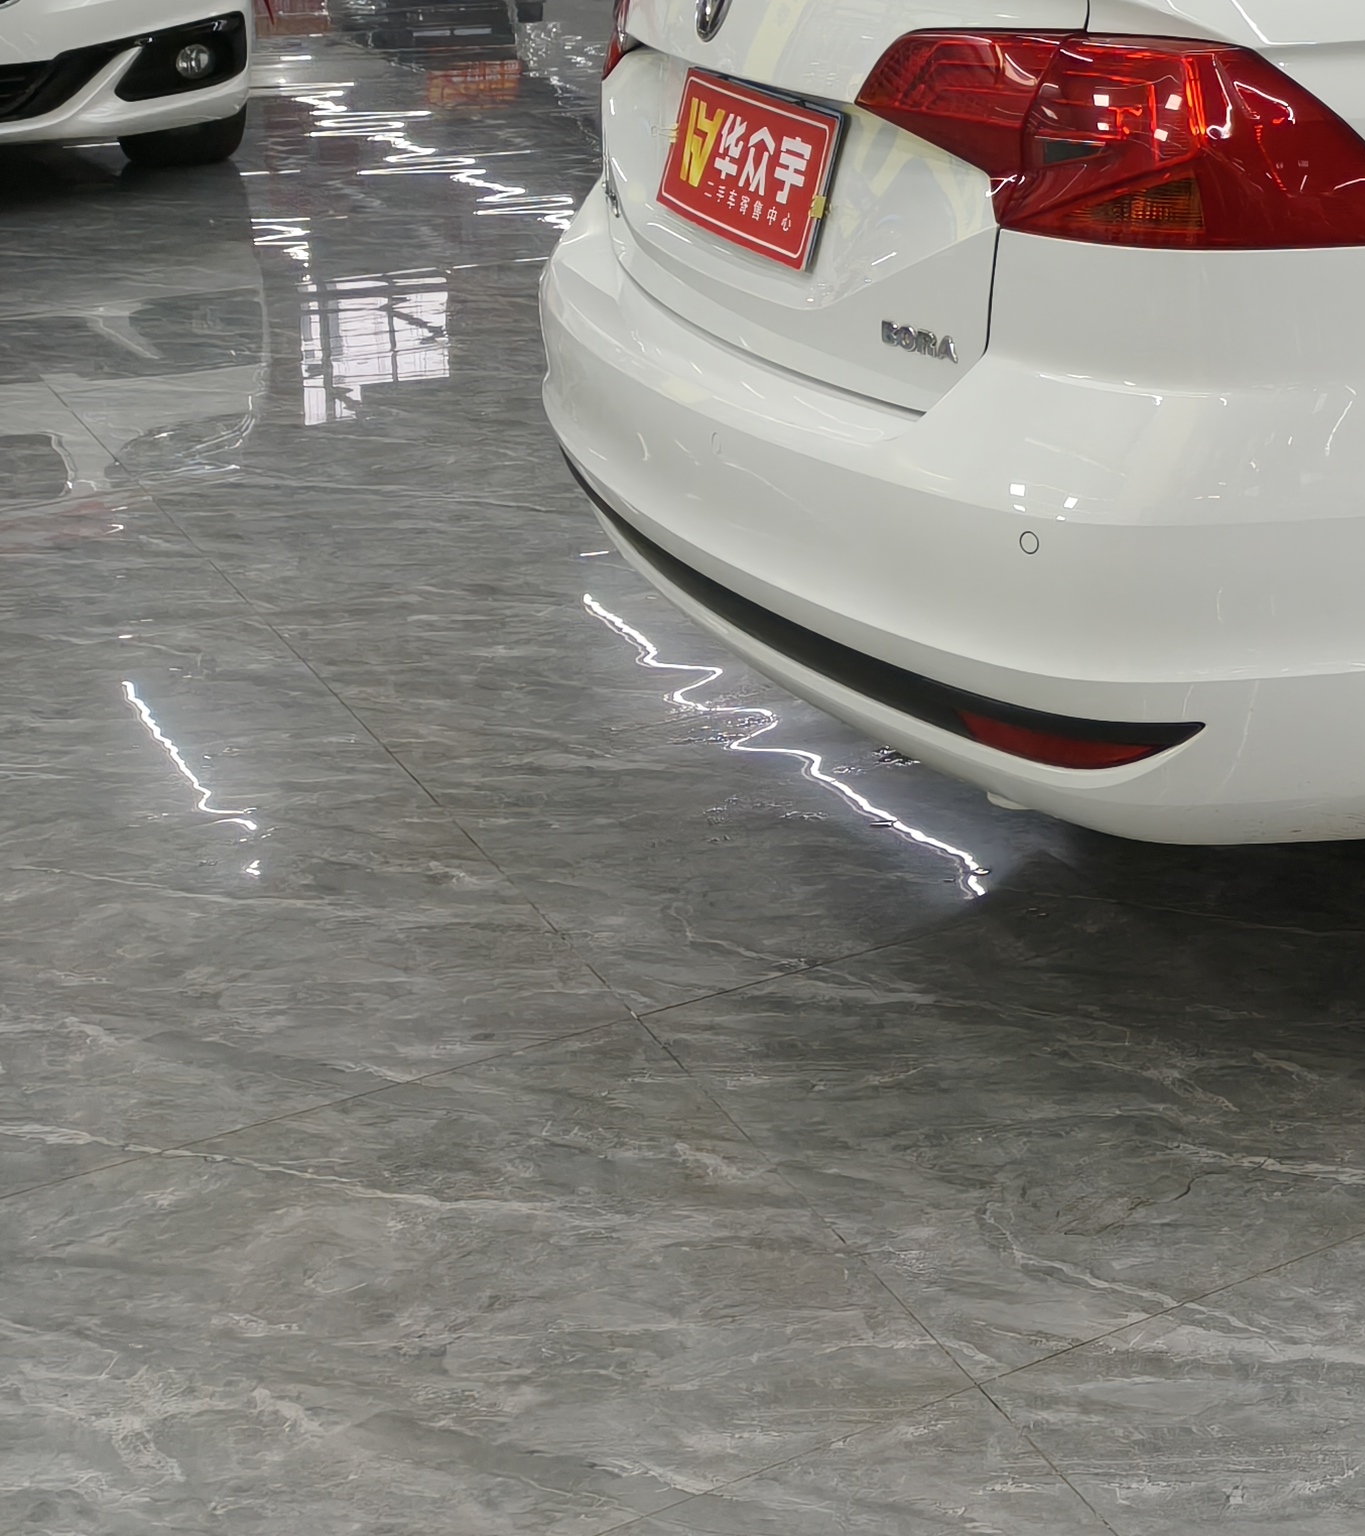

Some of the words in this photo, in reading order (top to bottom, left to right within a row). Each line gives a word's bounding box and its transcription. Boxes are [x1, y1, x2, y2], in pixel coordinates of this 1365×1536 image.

[714, 113, 813, 205] 华众宇
[881, 319, 959, 364] BORA
